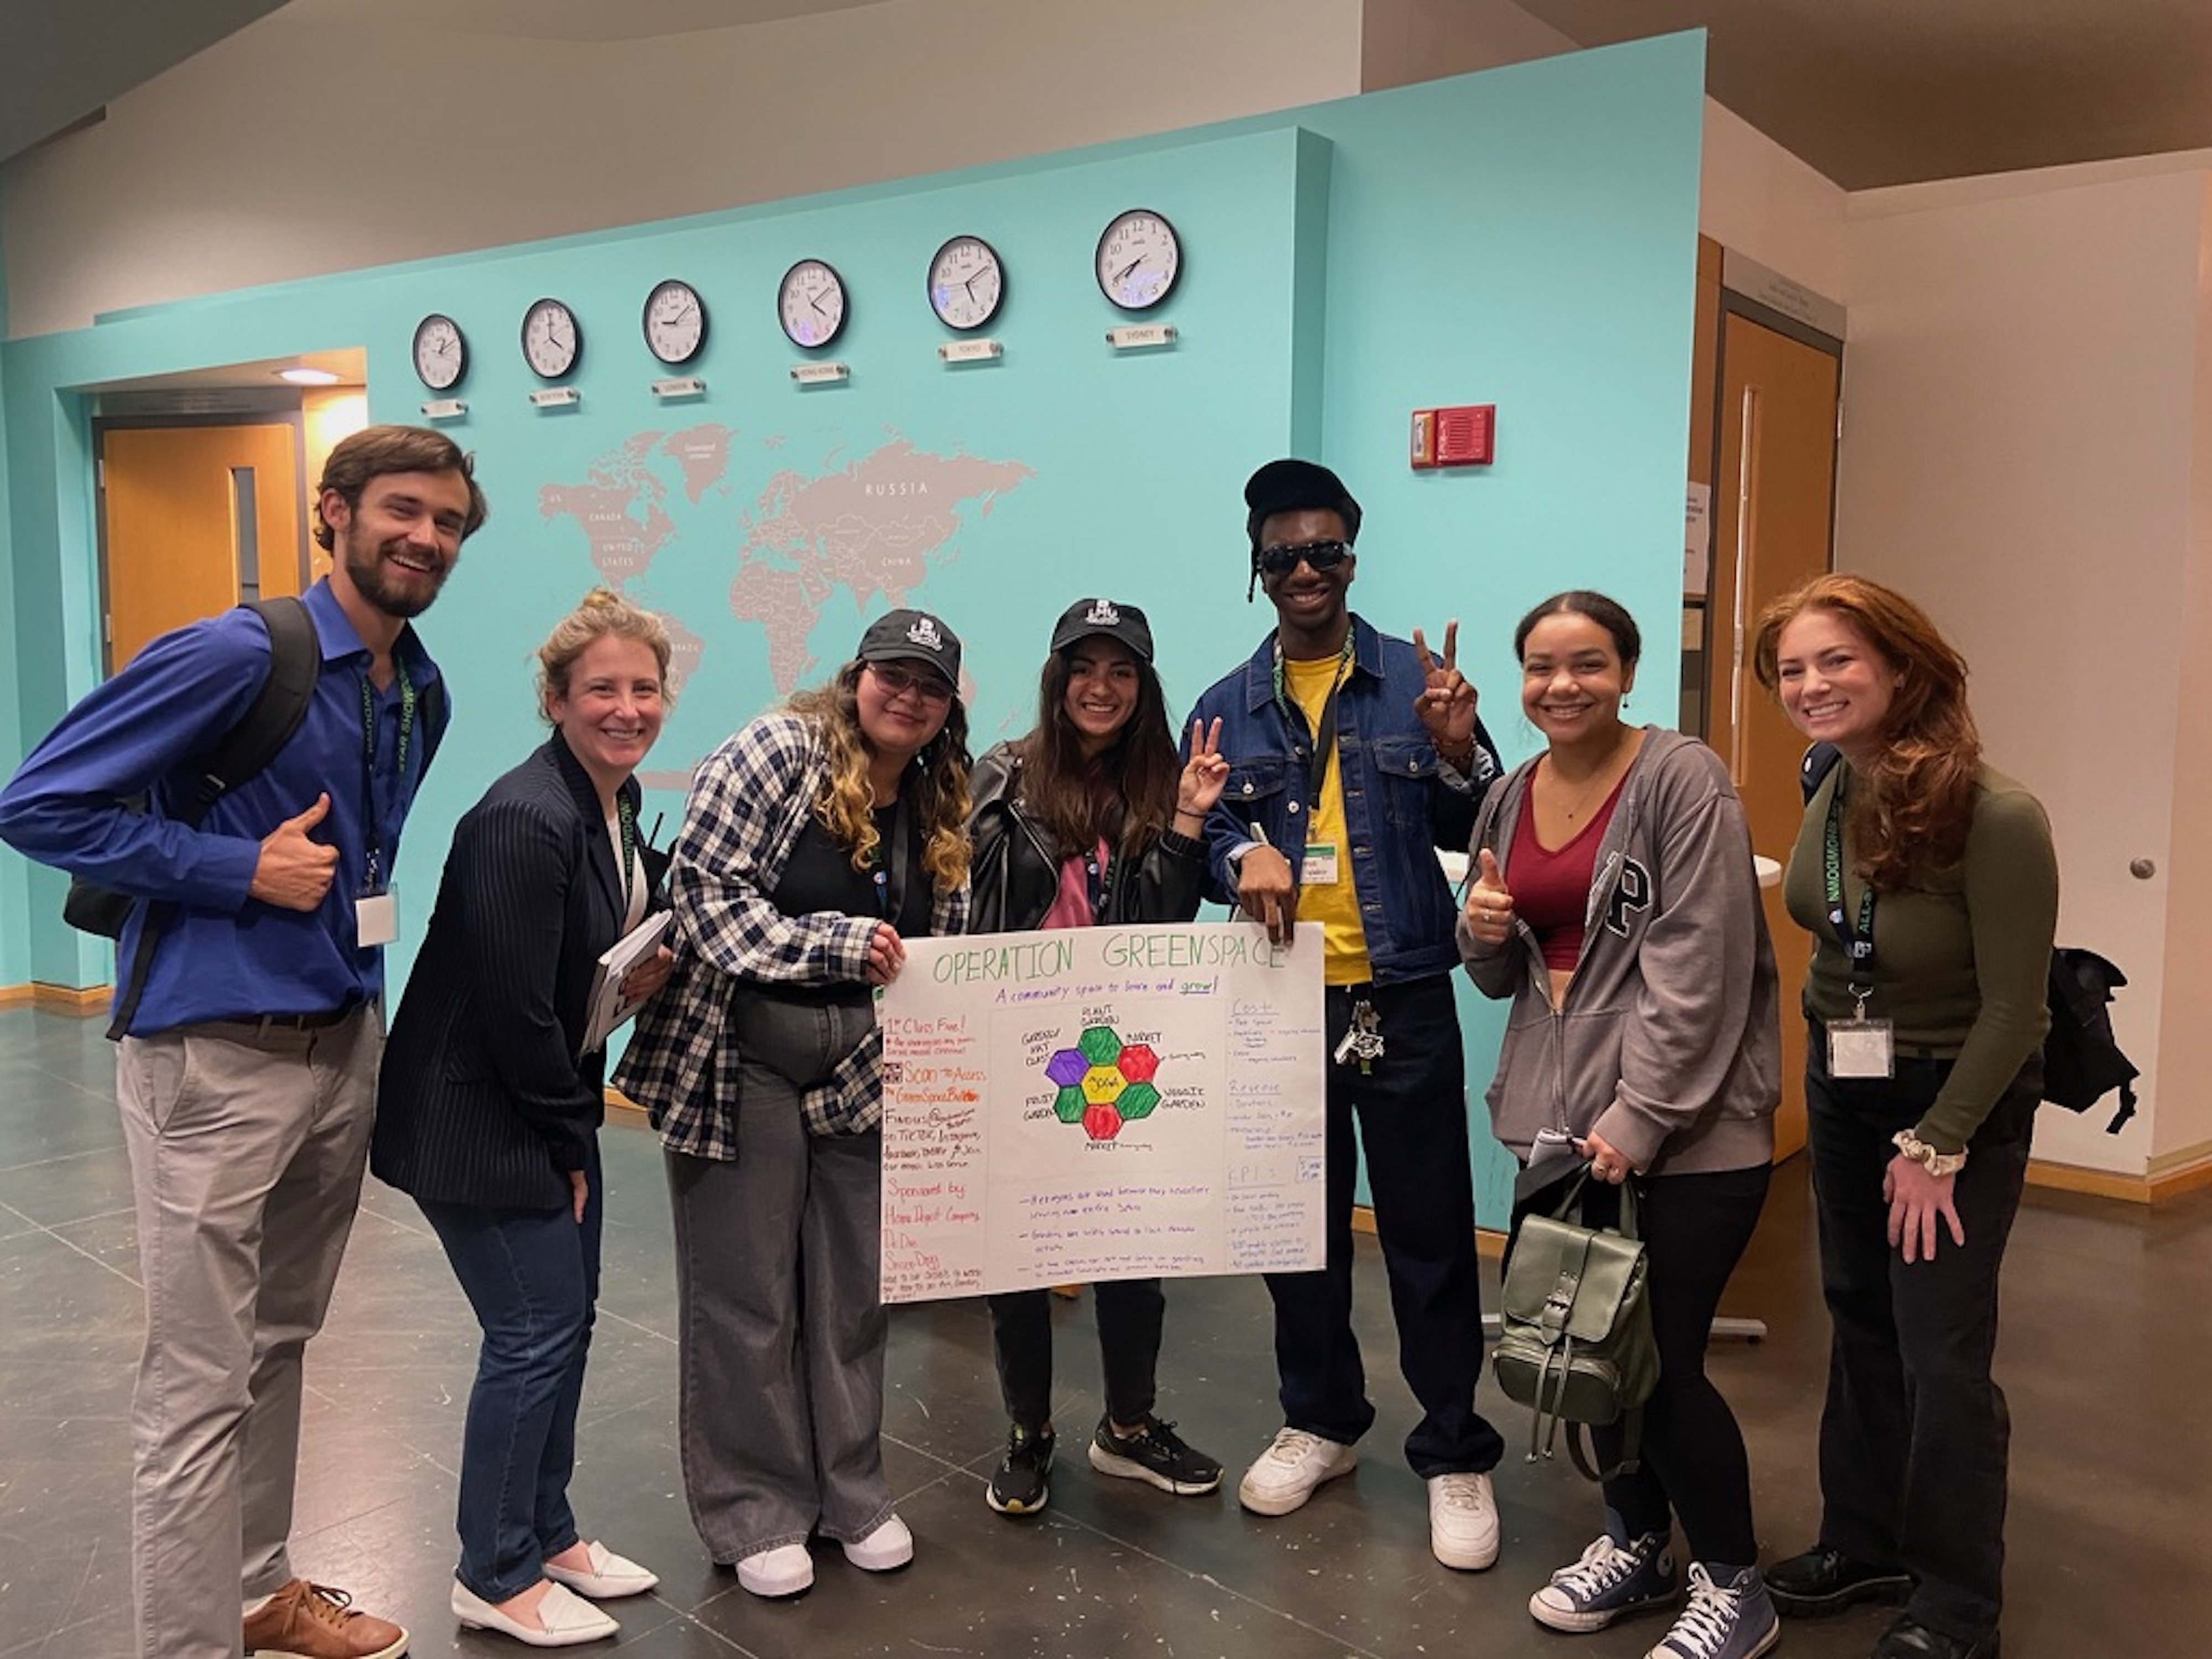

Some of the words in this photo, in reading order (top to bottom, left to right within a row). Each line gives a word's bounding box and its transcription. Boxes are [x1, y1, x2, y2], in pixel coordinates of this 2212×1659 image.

[1134, 220, 1144, 232] 12
[1152, 222, 1156, 233] 1
[1119, 229, 1128, 240] 11
[961, 246, 971, 257] 12
[948, 254, 958, 264] 11
[1151, 283, 1159, 295] 5
[865, 481, 928, 496] RUSSIA
[589, 512, 622, 523] CANADA
[602, 556, 634, 567] STATES
[880, 556, 912, 567] CHINA
[1825, 819, 1840, 902] SHOWDOWN
[1605, 851, 1653, 938] P
[933, 937, 1074, 985] OPERATION
[1102, 932, 1285, 968] GREENSPACE
[995, 988, 1006, 1004] A
[1010, 985, 1068, 1001] community
[1156, 977, 1174, 992] and
[1180, 975, 1219, 995] grow!
[1126, 1031, 1162, 1044] MARKET
[948, 1181, 964, 1199] by
